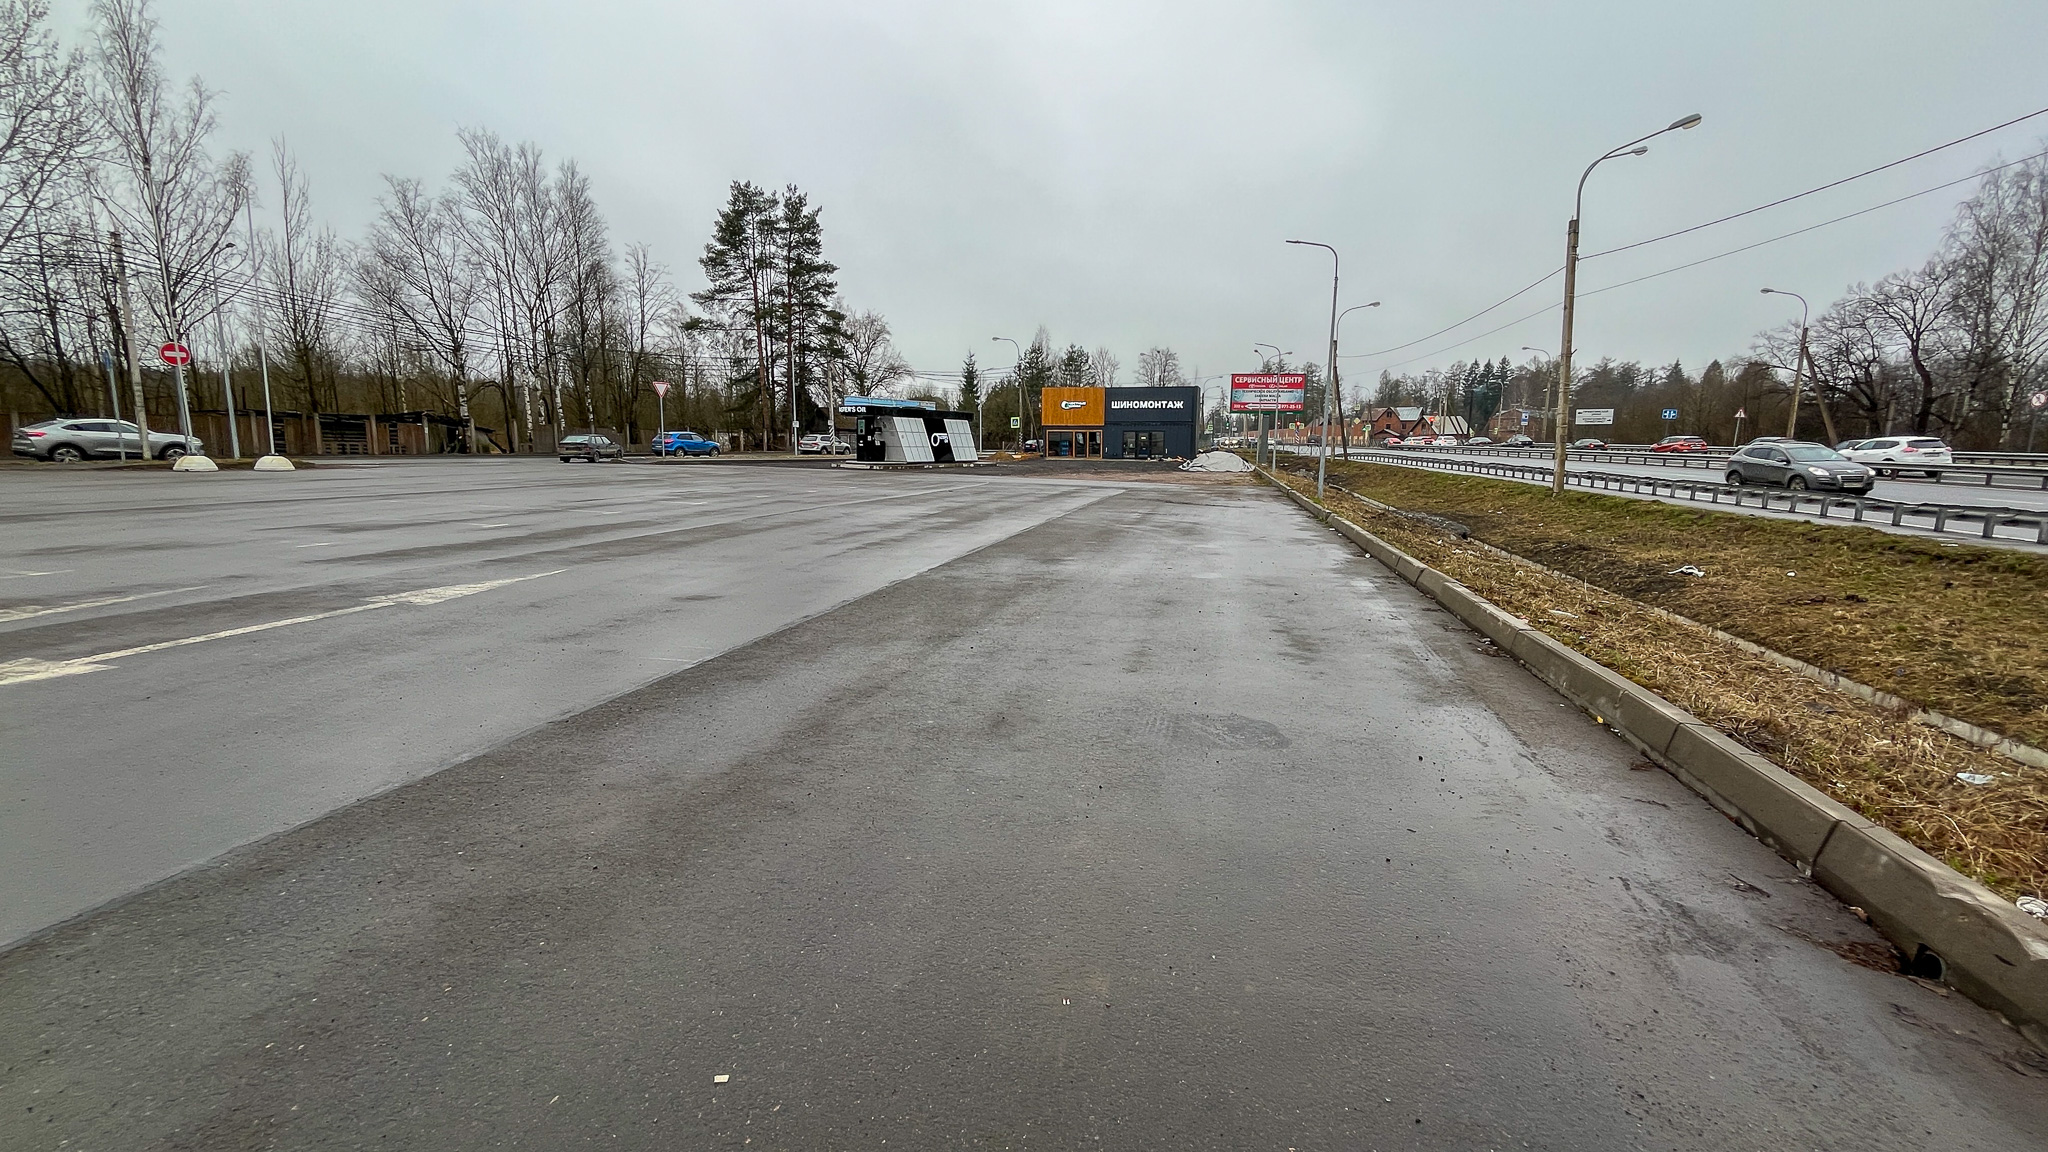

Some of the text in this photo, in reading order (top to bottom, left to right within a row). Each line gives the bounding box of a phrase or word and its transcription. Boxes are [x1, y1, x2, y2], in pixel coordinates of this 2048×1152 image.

[1234, 375, 1303, 384] СЕРВИСНЫЙ ЦЕНТР
[1111, 401, 1184, 409] ШИНОМОНТАЖ
